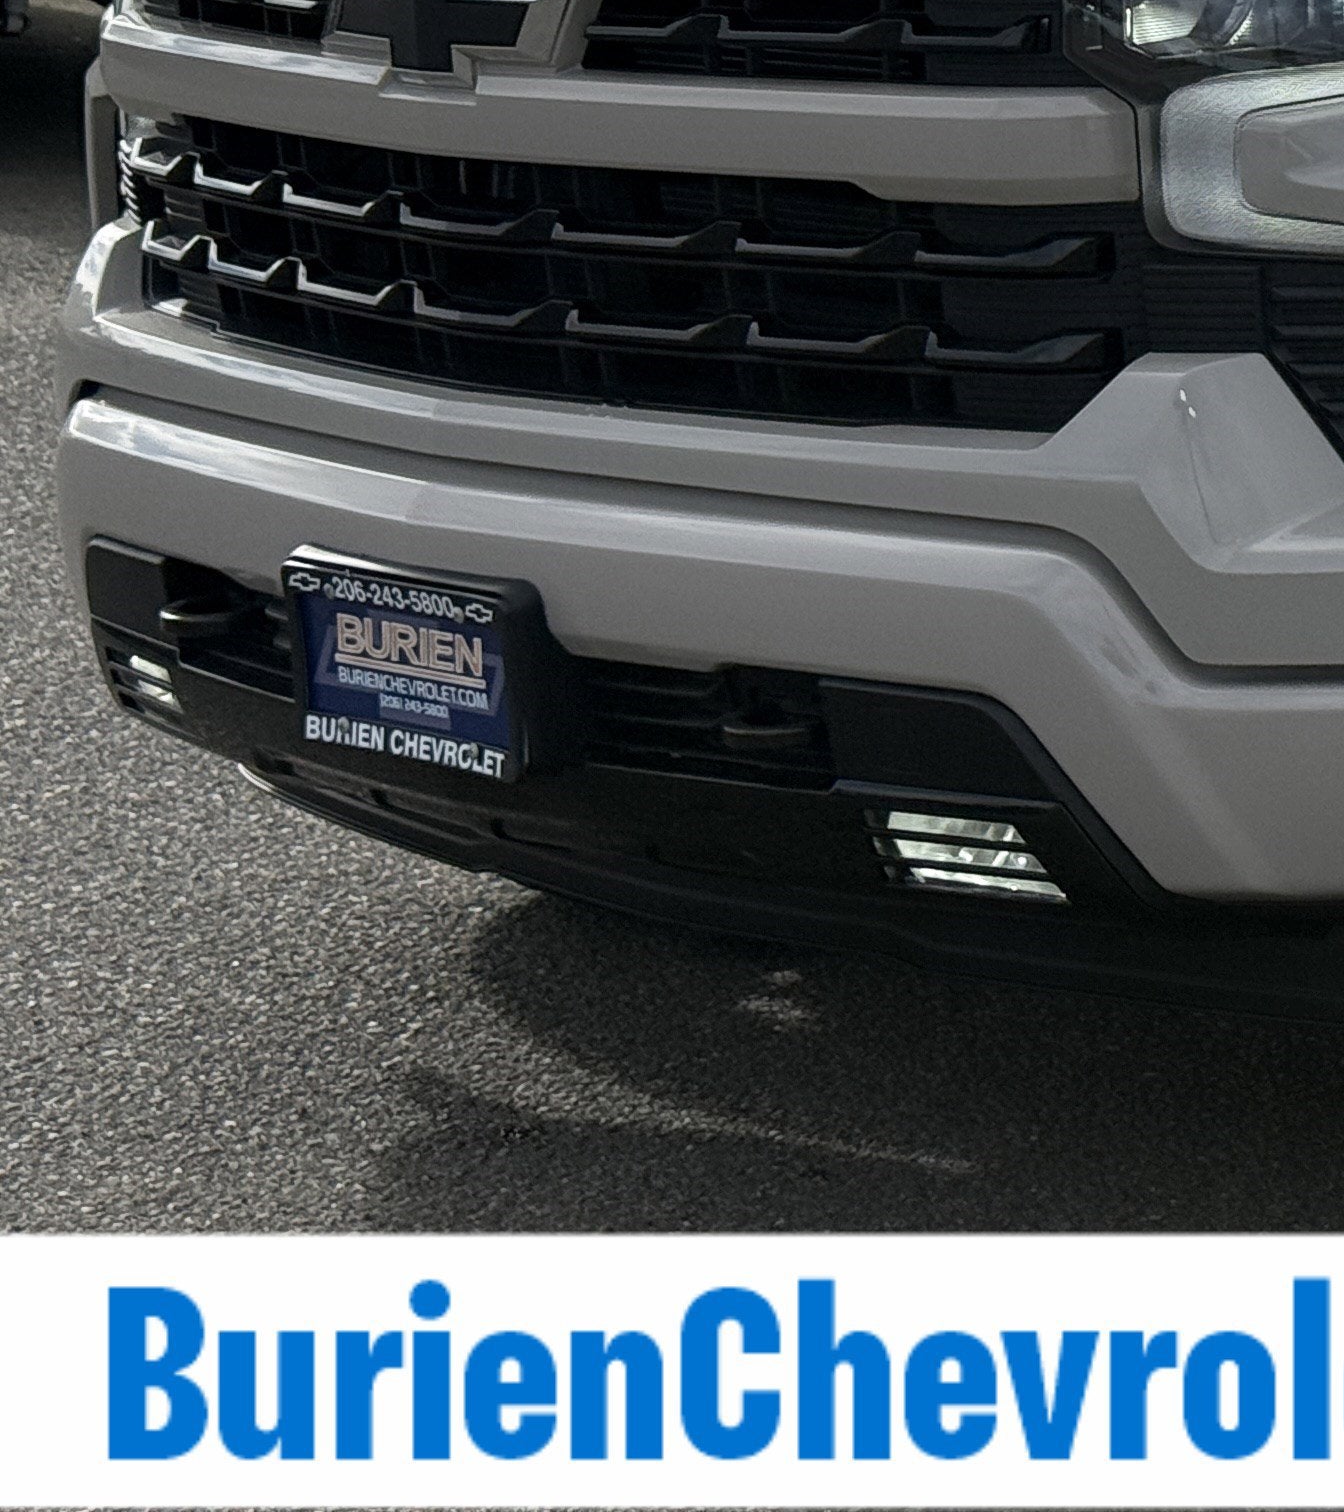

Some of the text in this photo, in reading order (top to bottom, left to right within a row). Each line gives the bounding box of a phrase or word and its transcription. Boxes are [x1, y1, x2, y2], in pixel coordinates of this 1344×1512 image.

[332, 576, 456, 619] 206-243-5800
[336, 612, 482, 677] BURIEN
[337, 665, 489, 711] BURIENCHEVROLET.COM
